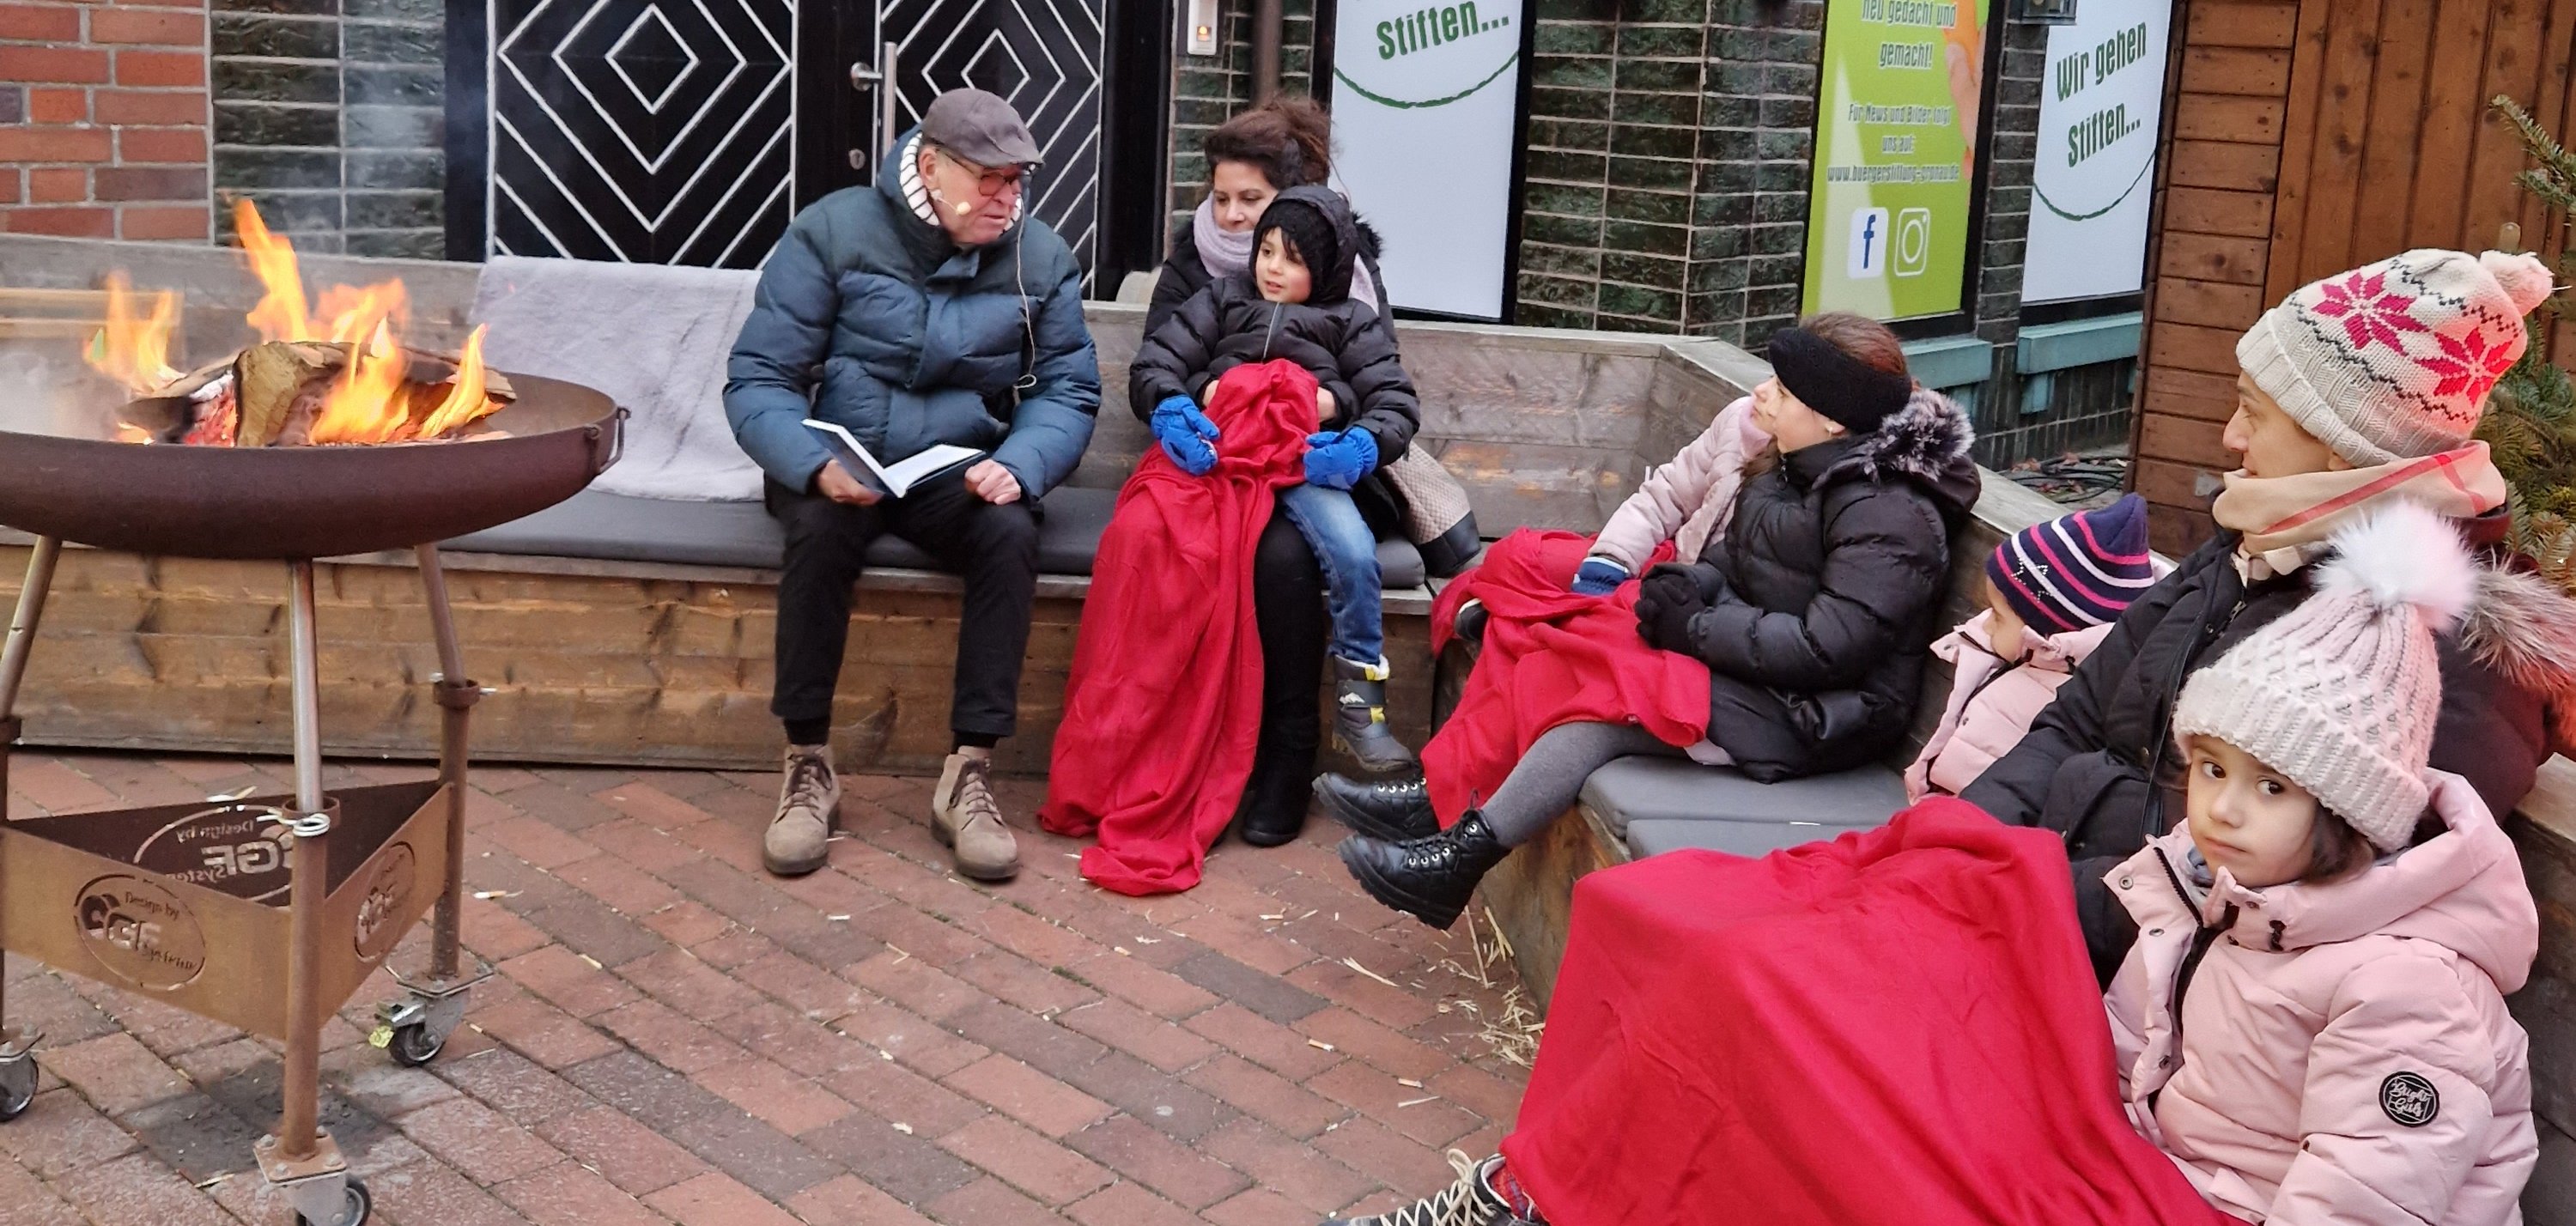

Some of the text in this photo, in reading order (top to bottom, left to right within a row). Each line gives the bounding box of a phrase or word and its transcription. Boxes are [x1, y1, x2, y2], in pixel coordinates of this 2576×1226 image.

[1862, 0, 1957, 27] neu gedacht und
[1879, 43, 1933, 68] gemacht!
[2057, 21, 2147, 102] Wir gehen
[1849, 102, 1863, 122] Für
[1865, 105, 1888, 123] News
[1890, 106, 1905, 123] und
[1906, 106, 1931, 124] Bilder
[1882, 137, 1897, 153] uns
